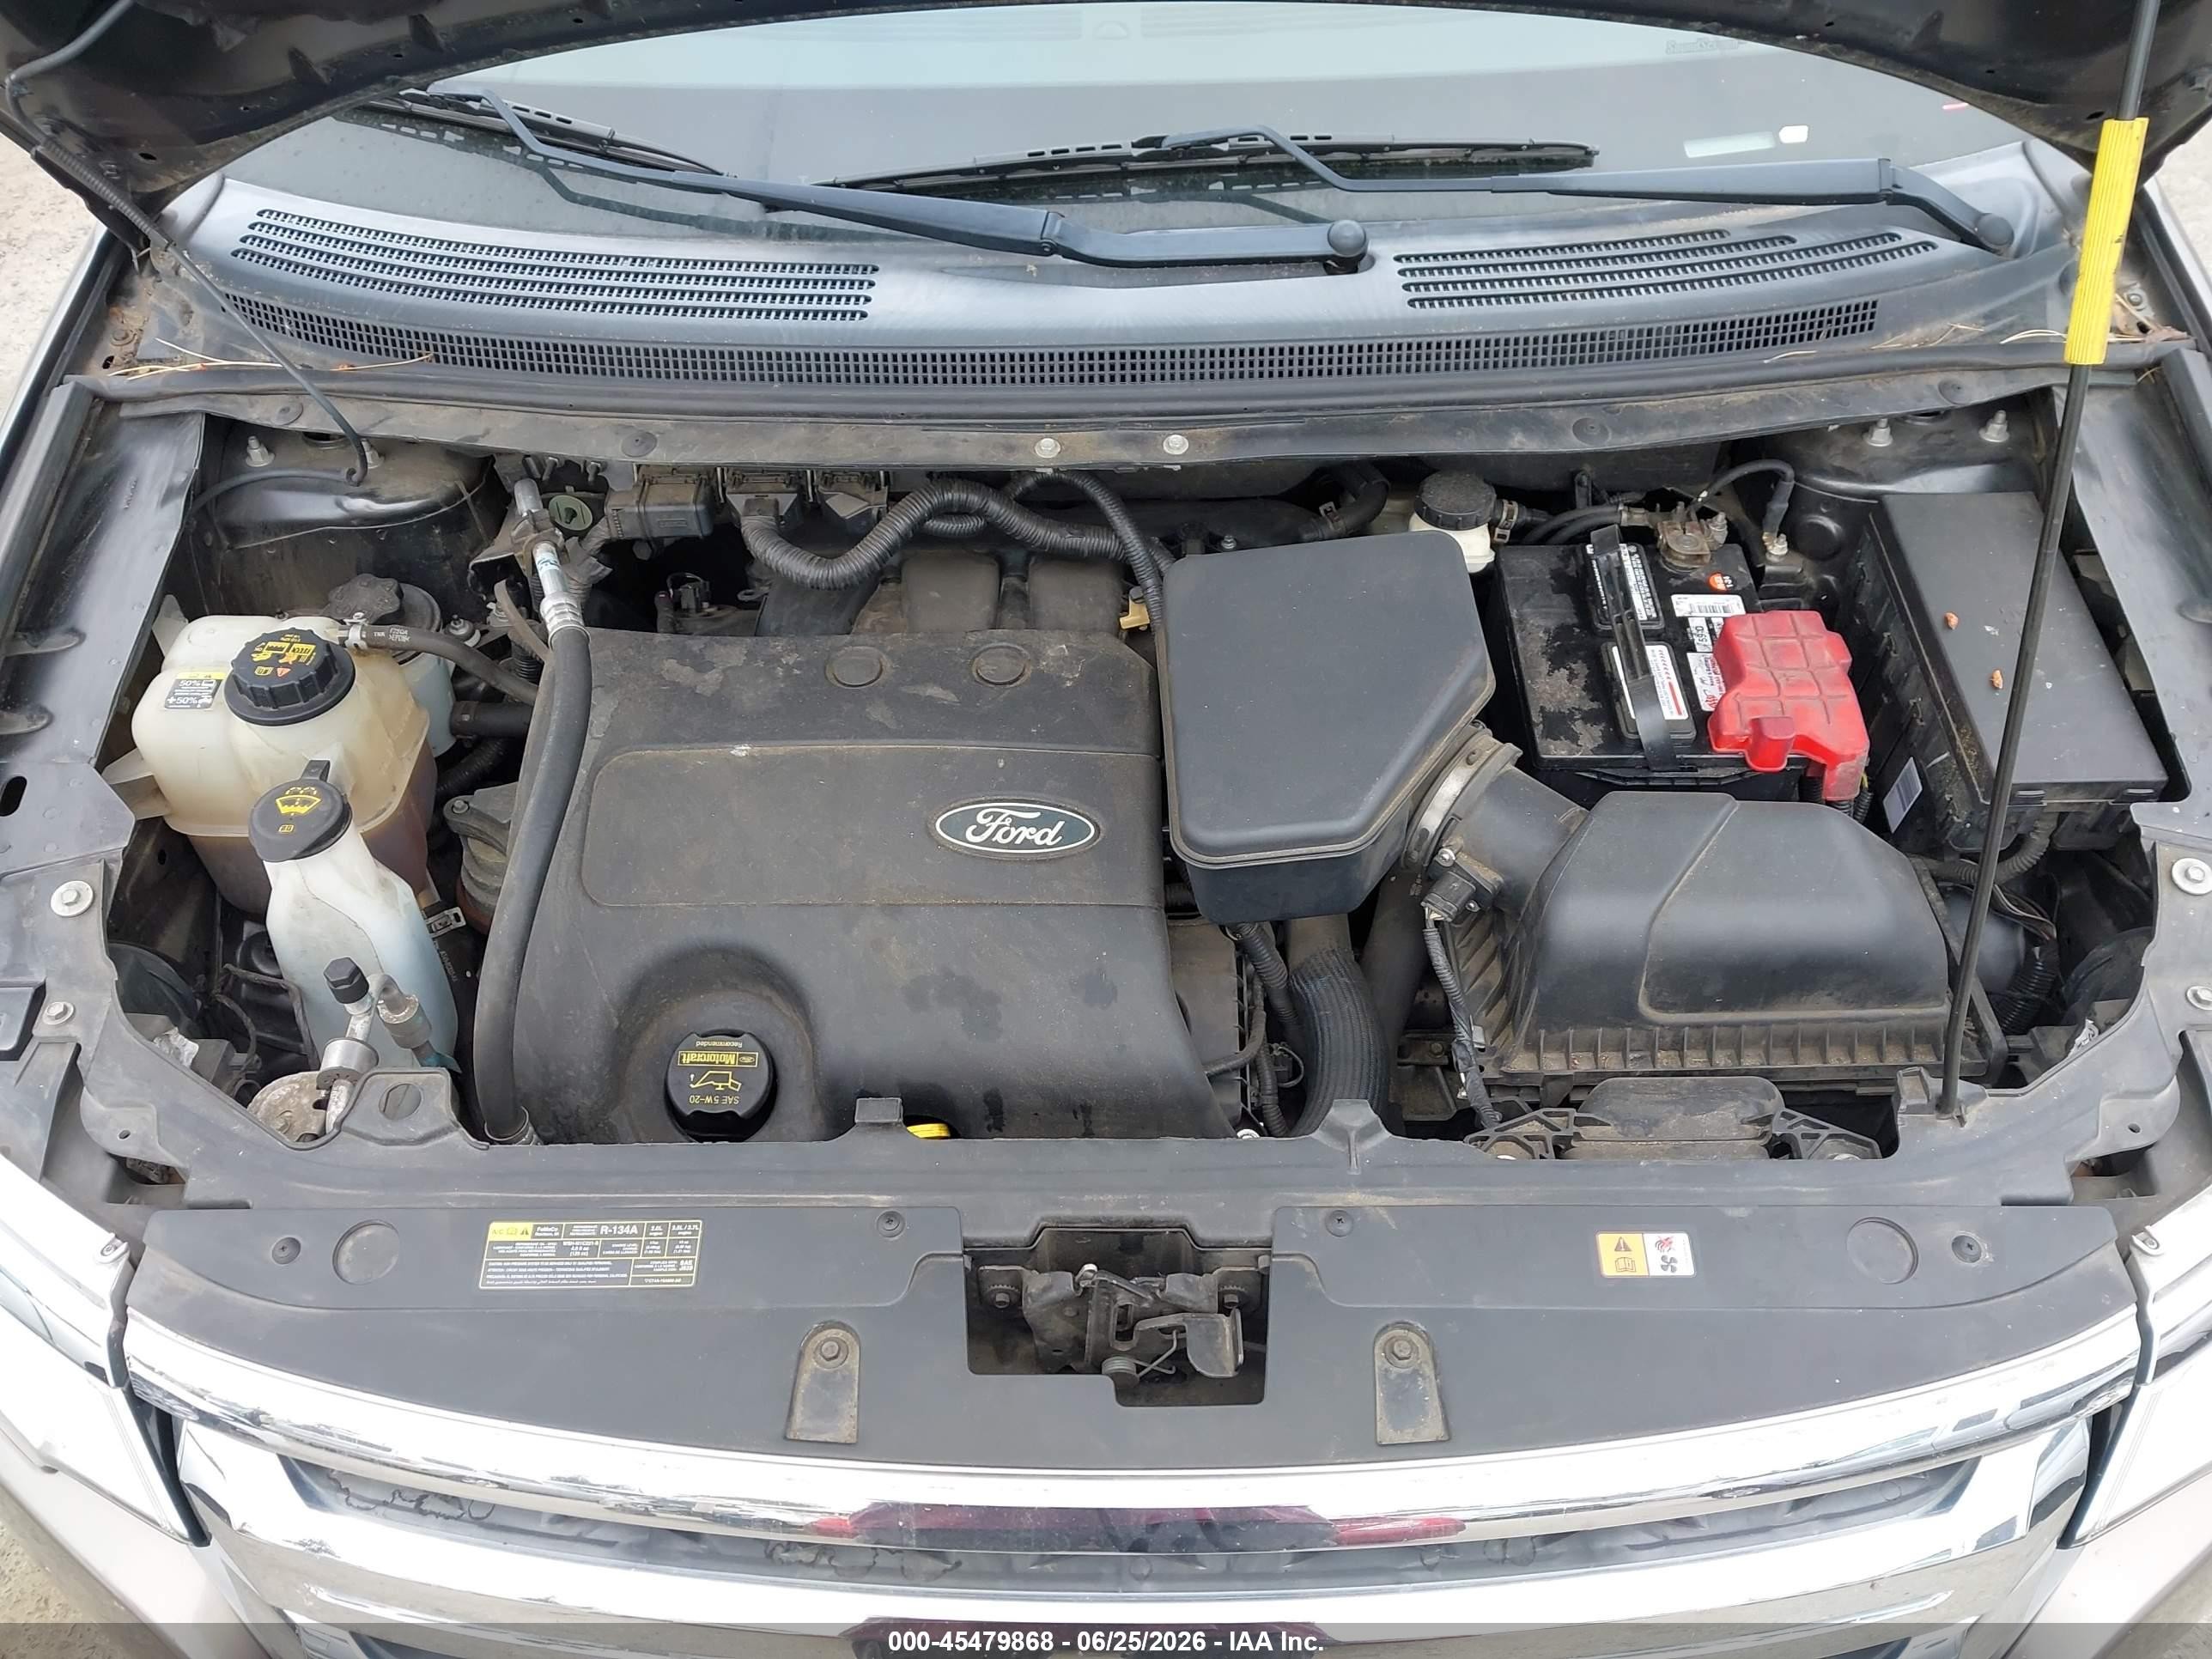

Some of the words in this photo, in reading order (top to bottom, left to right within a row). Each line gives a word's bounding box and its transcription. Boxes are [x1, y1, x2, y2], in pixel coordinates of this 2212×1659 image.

[965, 808, 1066, 846] Ford
[681, 1053, 736, 1064] Motorcraft
[689, 1095, 720, 1104] 5W-20
[721, 1095, 739, 1104] SAE
[599, 1224, 638, 1235] R-134A
